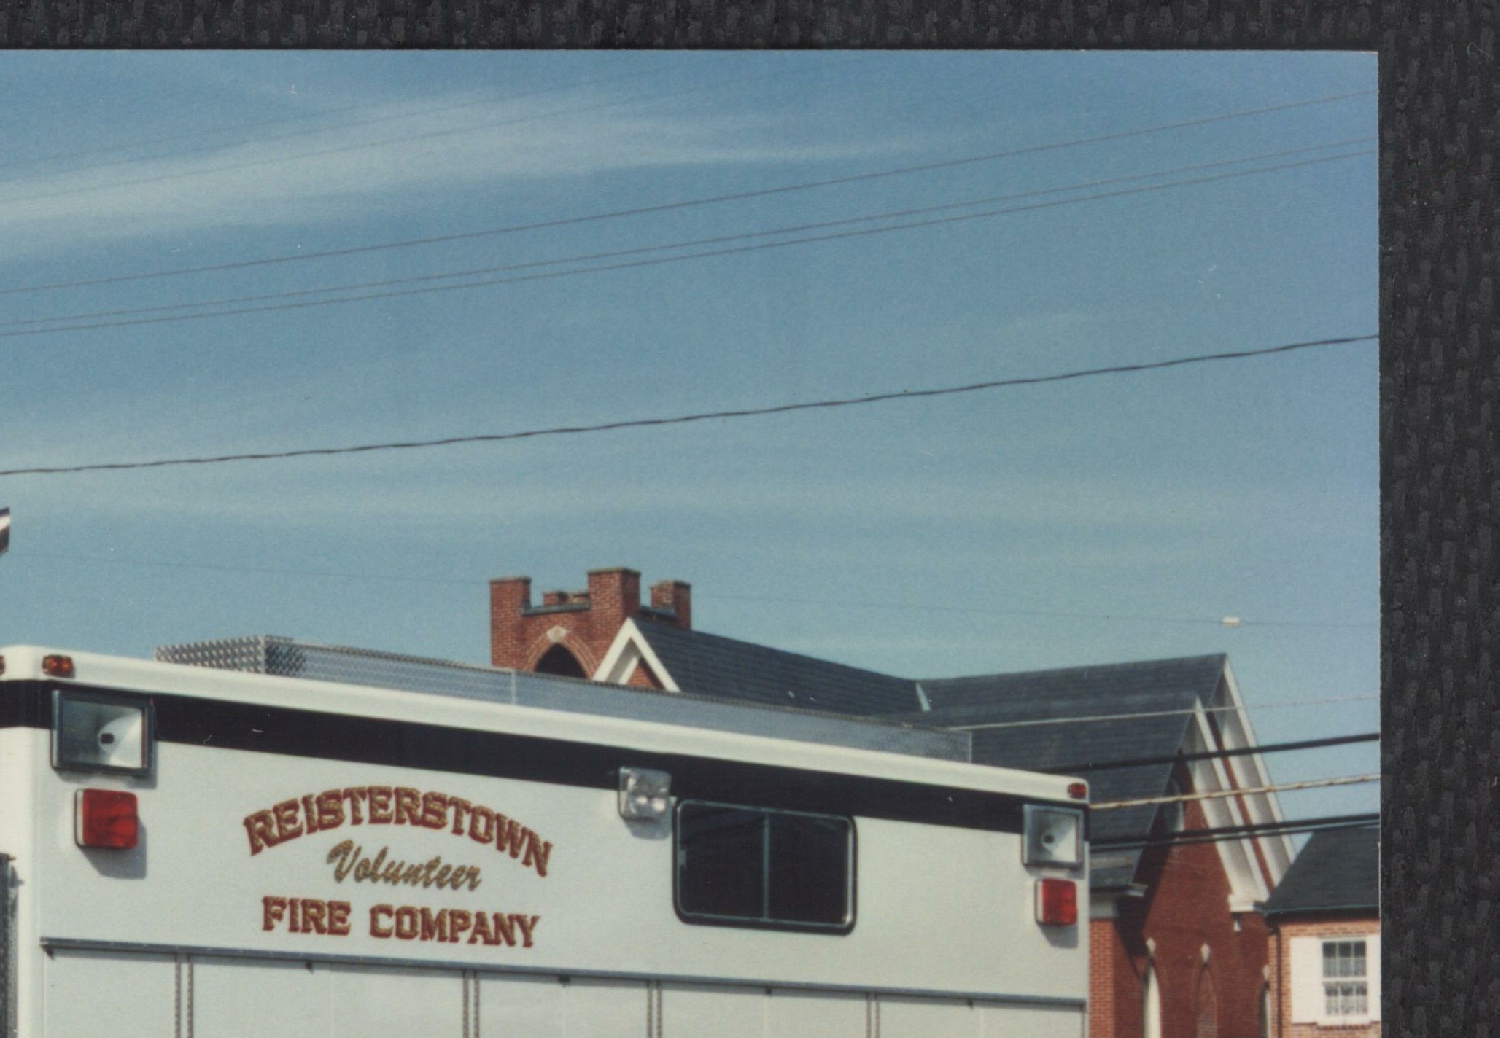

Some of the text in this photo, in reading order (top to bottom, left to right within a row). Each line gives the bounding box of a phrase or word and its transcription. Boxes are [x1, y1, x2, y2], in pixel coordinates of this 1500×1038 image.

[243, 785, 553, 878] REISTERSTOWN
[326, 839, 482, 892] Volunteer
[262, 895, 540, 948] FIRE COMPANY
